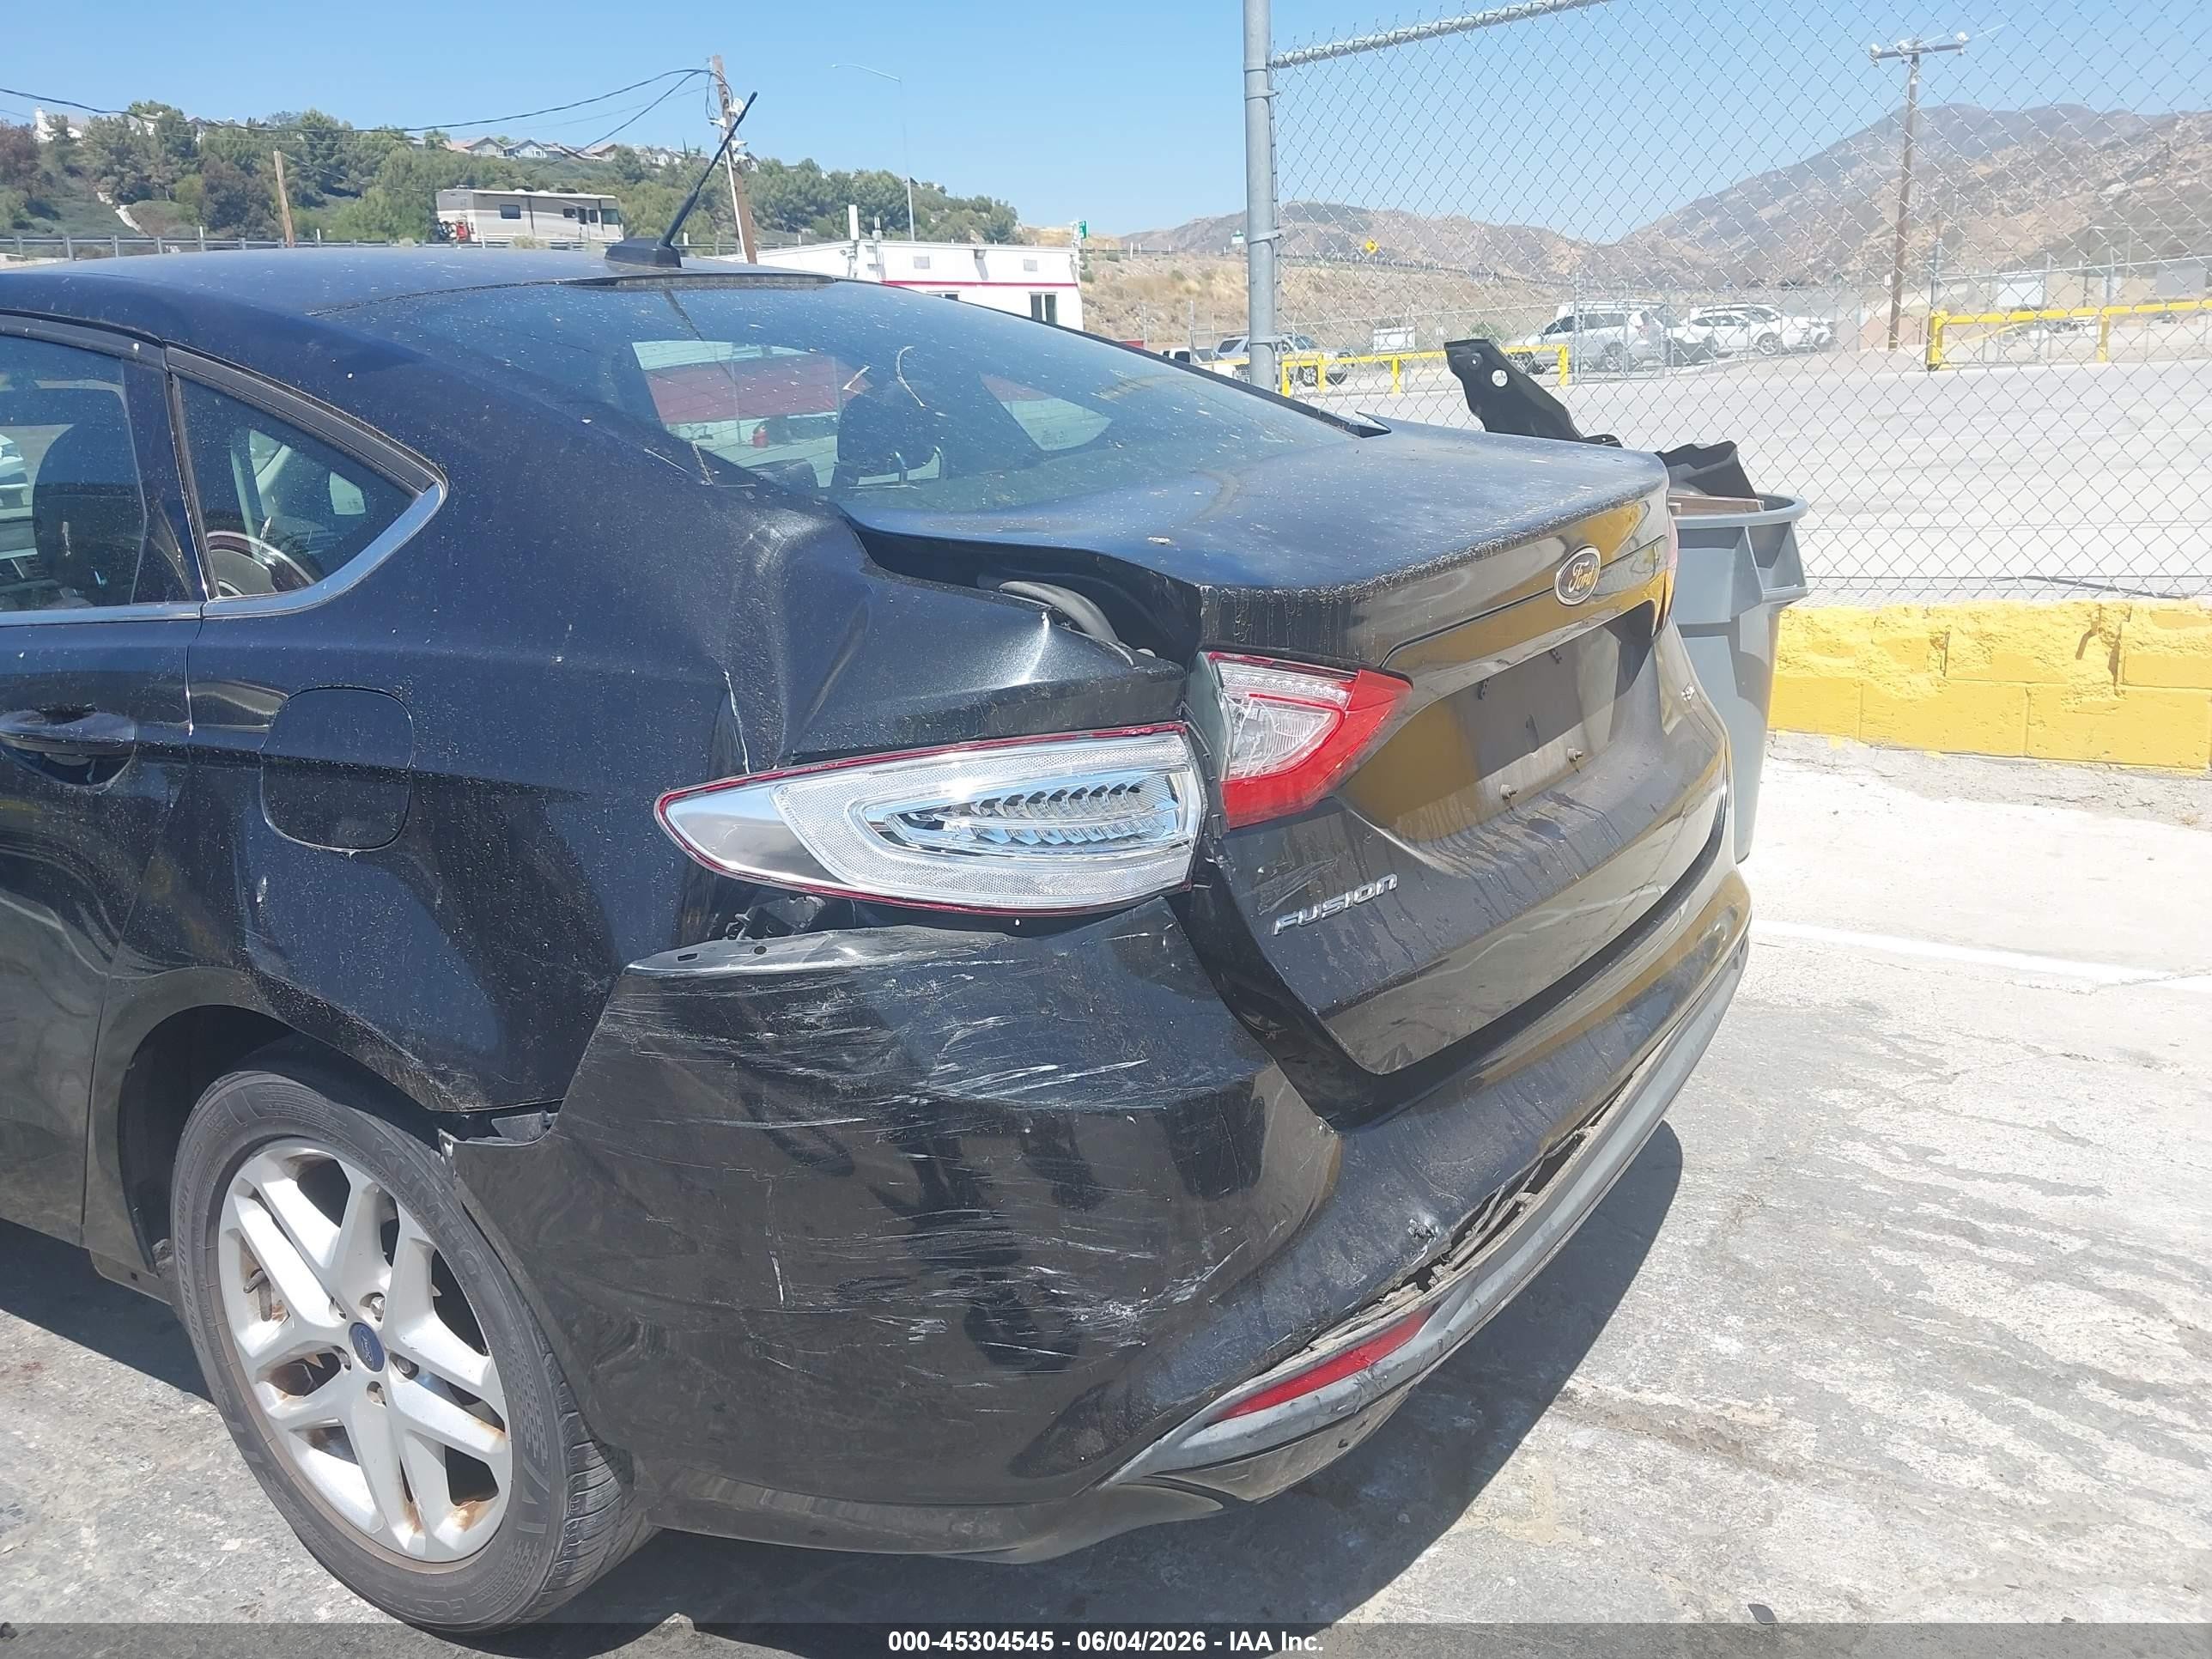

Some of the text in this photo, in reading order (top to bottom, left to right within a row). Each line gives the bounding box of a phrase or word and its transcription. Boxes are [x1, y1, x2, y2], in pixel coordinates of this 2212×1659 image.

[1568, 560, 1595, 593] Ford
[1272, 873, 1399, 937] FUSION
[372, 1136, 485, 1280] KUMHO
